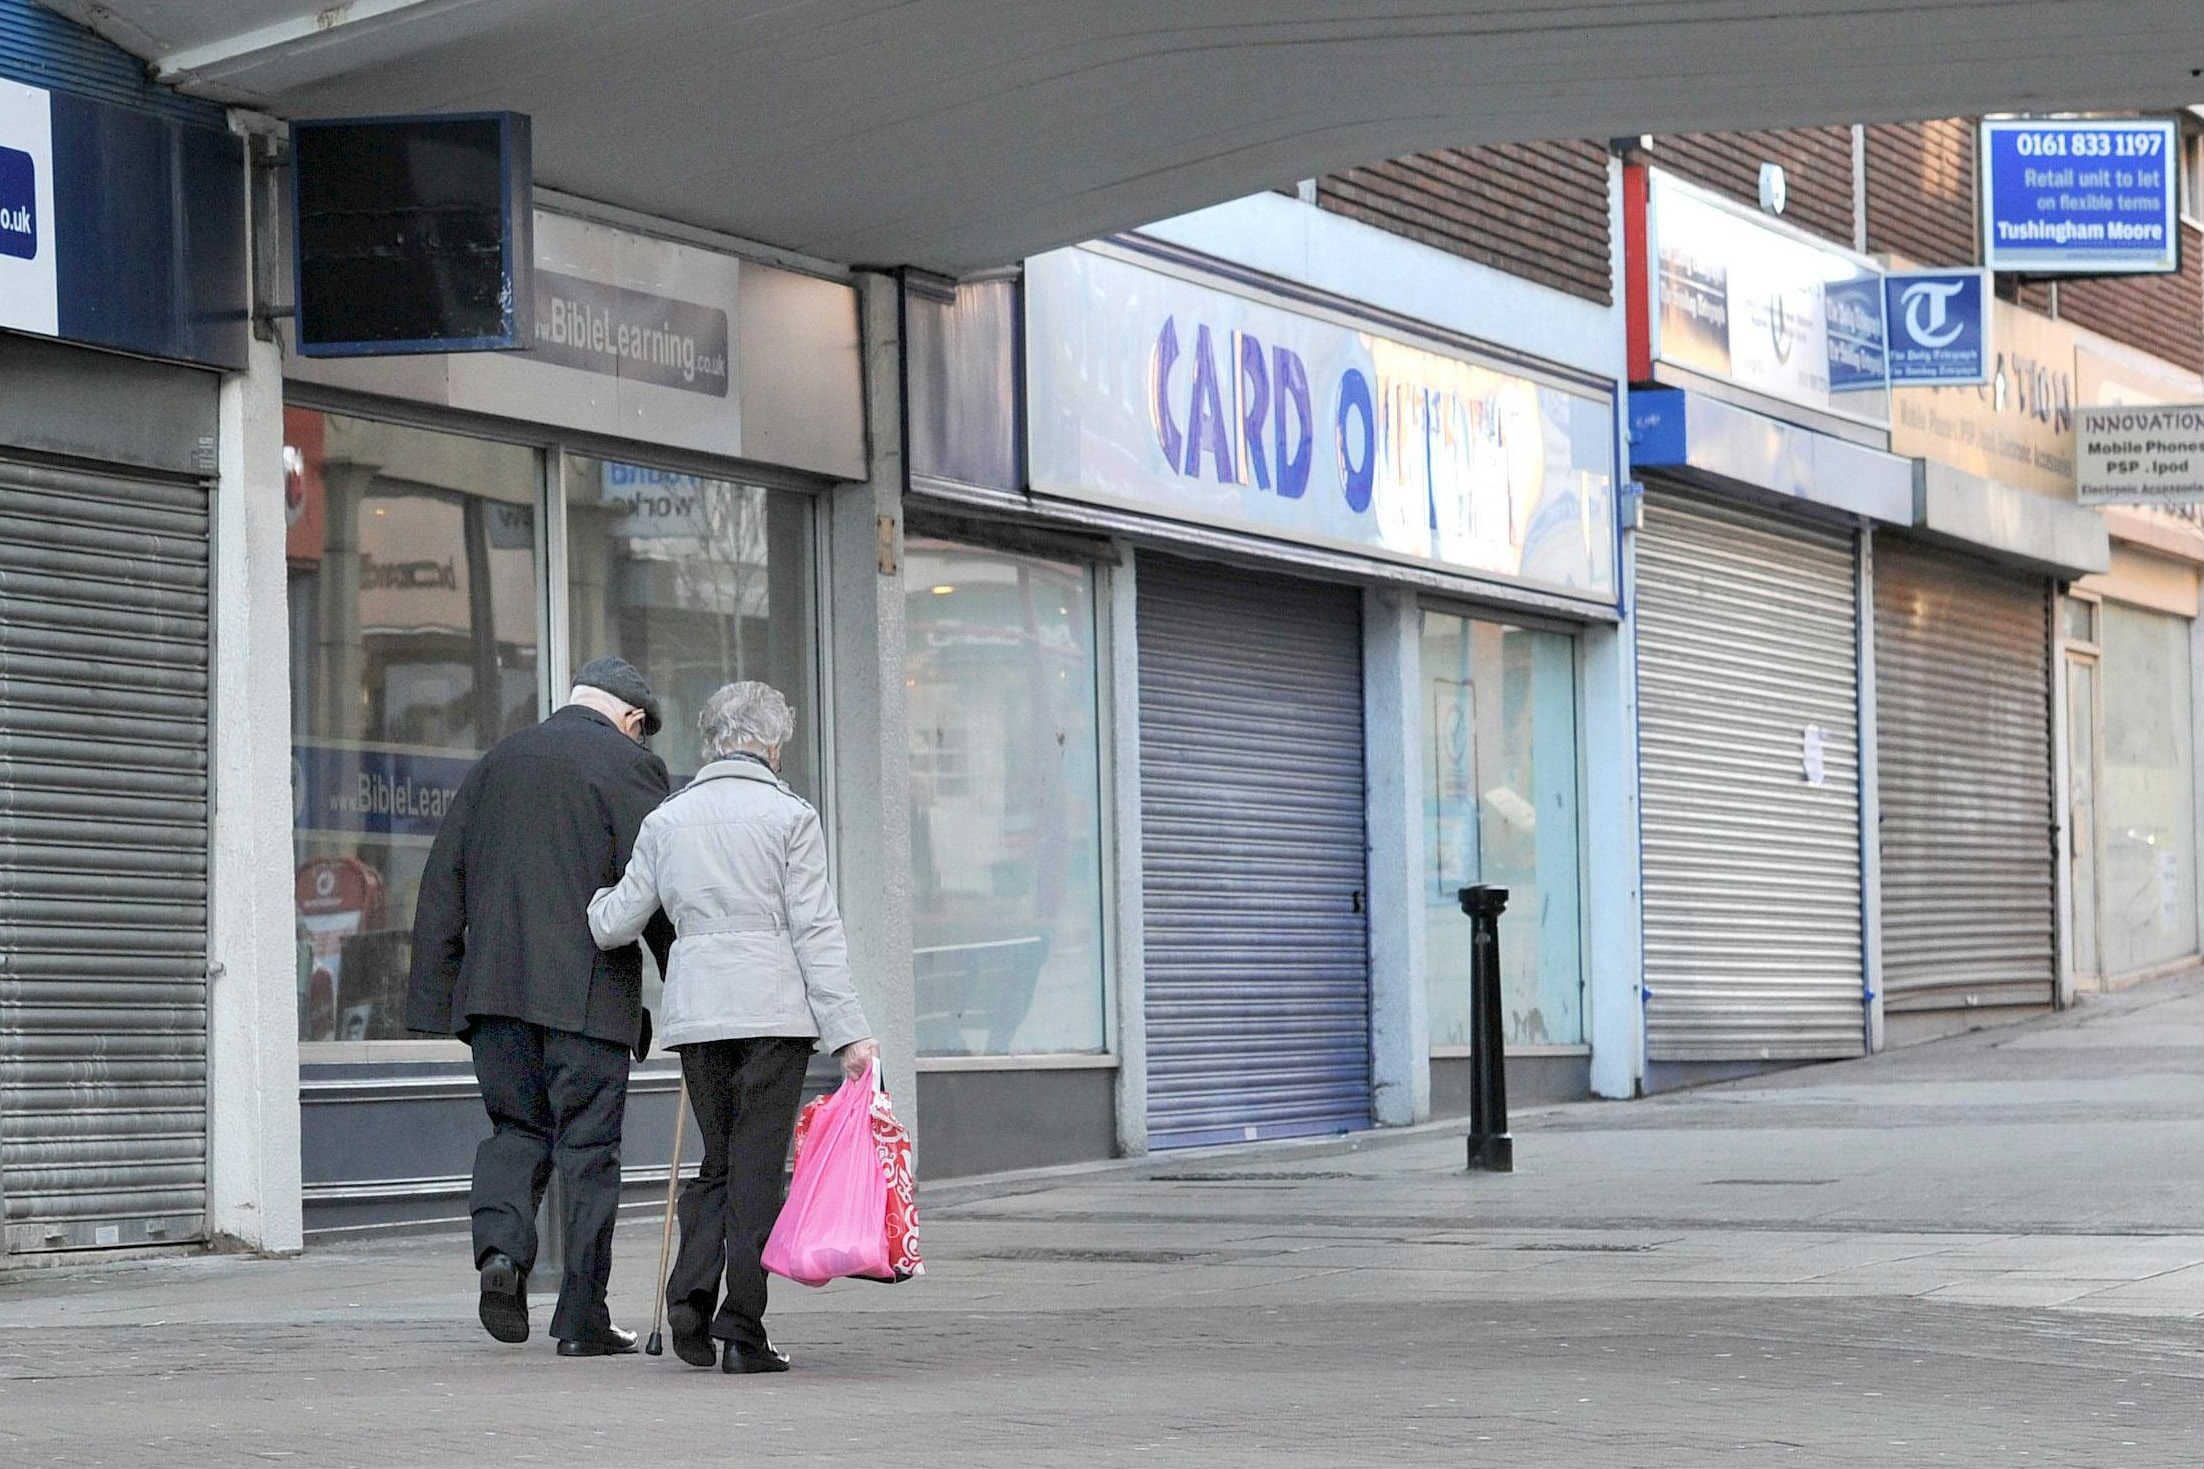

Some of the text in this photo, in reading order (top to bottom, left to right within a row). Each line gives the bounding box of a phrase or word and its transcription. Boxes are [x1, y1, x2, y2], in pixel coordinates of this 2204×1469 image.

[2016, 133, 2162, 156] 0161 833 1197
[2024, 168, 2160, 188] Retail unit to let
[2036, 194, 2161, 212] on flexible terms
[0, 206, 31, 234] o.uk
[1997, 219, 2162, 244] Tushingham Moore
[1149, 314, 1313, 499] CARD
[2088, 440, 2204, 455] Mobile Phones
[2106, 460, 2139, 473] PSP
